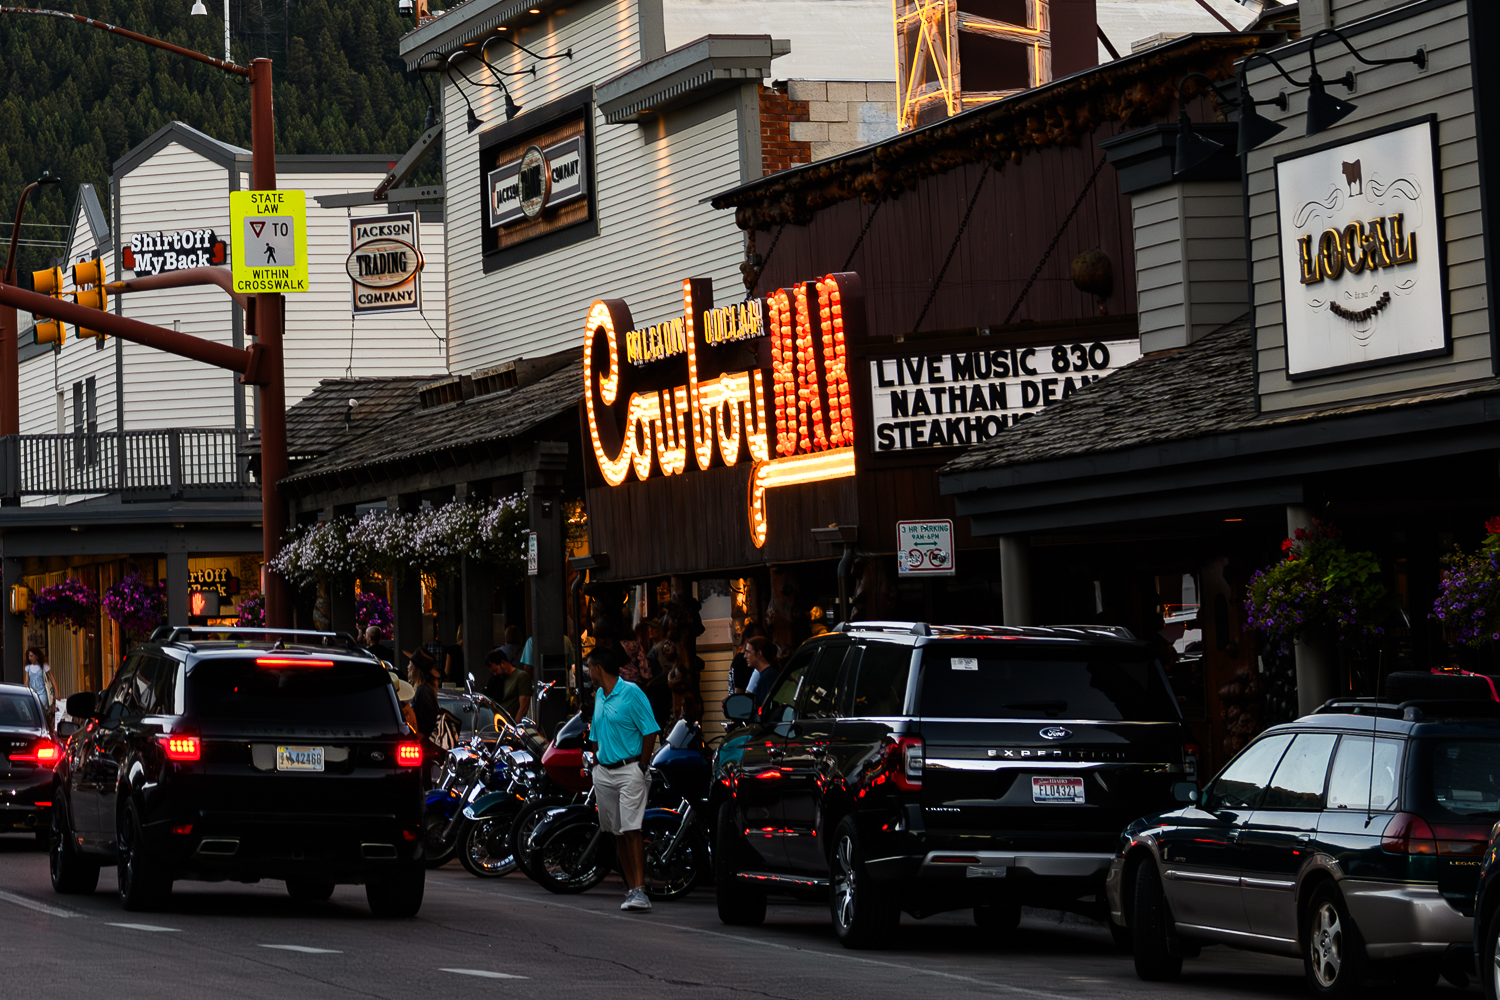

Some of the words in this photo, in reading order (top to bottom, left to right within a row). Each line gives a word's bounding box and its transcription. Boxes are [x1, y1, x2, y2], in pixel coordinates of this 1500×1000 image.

[251, 193, 284, 203] STATE
[257, 204, 279, 214] LAW
[272, 222, 288, 237] TO
[357, 223, 410, 241] JACKSON
[131, 229, 213, 252] ShirtOff
[1297, 212, 1418, 285] LOCAL
[133, 250, 210, 275] MyBack
[356, 251, 407, 276] TRADING
[252, 269, 289, 279] WITHIN
[237, 279, 304, 290] CROSSWALK
[358, 290, 413, 304] COMPANY
[767, 272, 854, 457] BAR
[876, 355, 945, 387] LIVE
[951, 347, 1038, 383] MUSIC
[1051, 342, 1110, 374] 830
[890, 381, 1008, 418] NATHAN
[920, 525, 949, 533] PARKING
[1047, 729, 1066, 737] Ford
